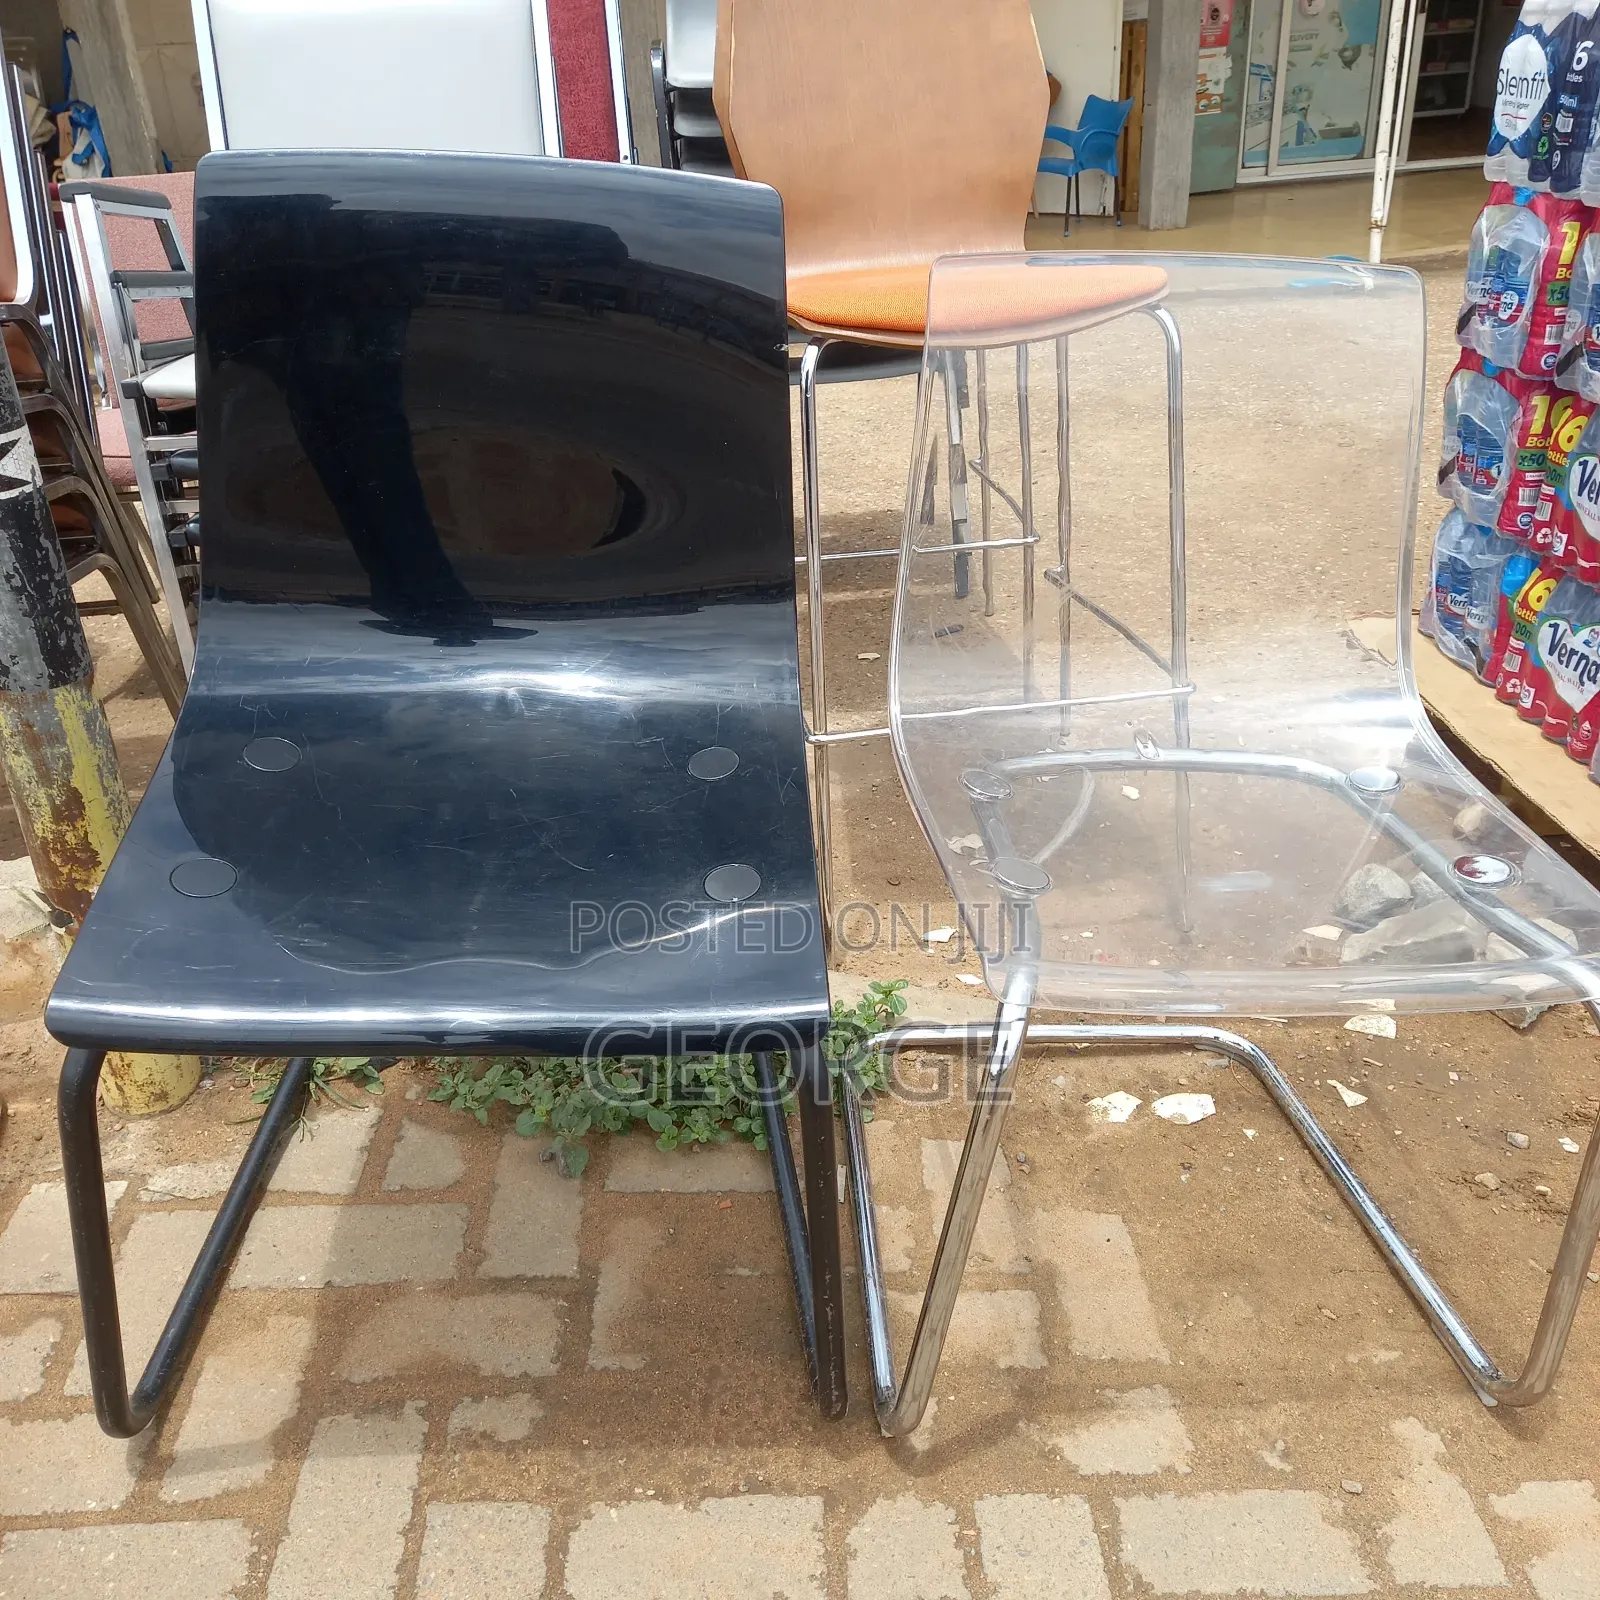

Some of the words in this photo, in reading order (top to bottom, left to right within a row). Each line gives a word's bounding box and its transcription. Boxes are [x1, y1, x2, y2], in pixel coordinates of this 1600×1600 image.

[1290, 32, 1320, 42] ELIVERY
[1572, 41, 1594, 71] 6
[1497, 68, 1546, 100] Slemfit
[1557, 221, 1581, 265] 1
[1547, 447, 1570, 467] ottles
[1577, 459, 1600, 505] Ver
[1548, 622, 1600, 687] Verna
